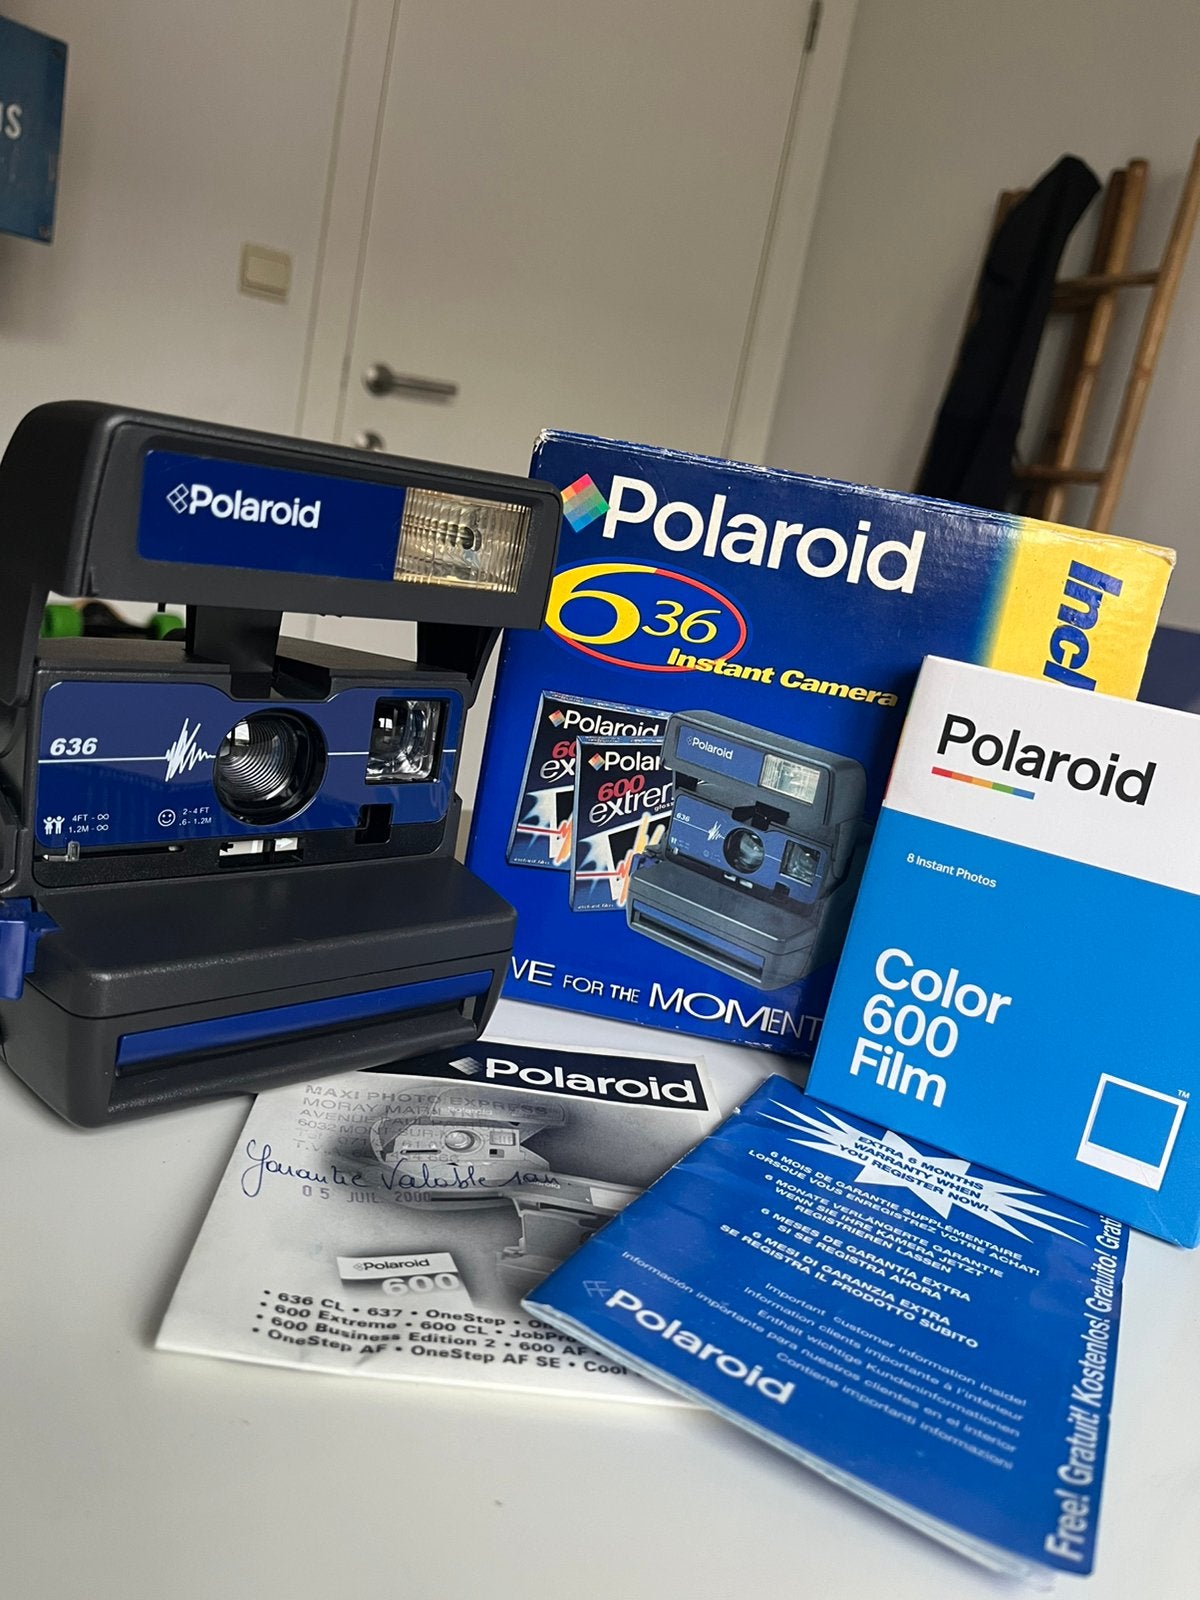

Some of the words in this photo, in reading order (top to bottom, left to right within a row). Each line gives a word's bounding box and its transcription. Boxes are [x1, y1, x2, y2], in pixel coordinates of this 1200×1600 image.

[189, 484, 321, 528] Polaroid
[603, 475, 926, 594] Polaroid
[545, 563, 722, 644] 636
[667, 648, 775, 684] Instant
[780, 670, 898, 708] Camera
[50, 738, 98, 756] 636
[692, 737, 733, 760] Polaroid
[937, 714, 1157, 806] Polaroid
[72, 814, 88, 822] 4FT
[598, 775, 645, 802] 600
[676, 812, 691, 822] 636
[68, 826, 90, 834] 1.2M
[907, 852, 916, 864] 8
[916, 854, 954, 876] Instant
[956, 868, 997, 889] Photos
[563, 974, 604, 997] FOR
[610, 984, 641, 1004] THE
[648, 982, 824, 1042] MOMENT
[875, 948, 1013, 1025] Color
[862, 994, 959, 1058] 600
[303, 1097, 378, 1113] MORAY
[306, 1084, 360, 1100] MAXI
[368, 1092, 440, 1103] PHOTO
[450, 1096, 548, 1115] EXPRESS
[486, 1058, 698, 1104] Polaroid
[850, 1036, 947, 1108] Film
[298, 1118, 337, 1132] 6032
[300, 1109, 377, 1123] AVENUE
[840, 1144, 869, 1161] YOU
[872, 1160, 944, 1195] REGISTER
[948, 1192, 989, 1212] NOW!
[854, 1142, 933, 1179] WARRANTY
[936, 1176, 981, 1199] WHEN
[858, 1136, 904, 1159] EXTRA
[921, 1162, 984, 1190] MONTHS
[748, 1150, 807, 1180] LORSQUE
[810, 1177, 843, 1196] VOUS
[846, 1193, 937, 1234] ENREGISTREZ
[940, 1231, 987, 1255] VOTRE
[988, 1252, 1040, 1277] ACHAT!
[775, 1186, 814, 1208] WENN
[816, 1204, 839, 1218] SIE
[841, 1214, 874, 1232] IHRE
[876, 1228, 935, 1259] KAMERA
[938, 1256, 984, 1277] JETZT
[776, 1179, 831, 1206] MONATE
[833, 1202, 930, 1247] VERLÄNGERTE
[932, 1244, 1004, 1279] GARANTIE
[781, 1156, 813, 1174] MOIS
[814, 1172, 833, 1183] DE
[836, 1180, 900, 1211] GARANTIE
[902, 1208, 1023, 1261] SUPPLÉMENTAIRE
[794, 1204, 894, 1250] REGISTRIEREN
[896, 1246, 952, 1274] LASSEN
[363, 1258, 431, 1271] Polaroid
[382, 1273, 460, 1297] 600
[720, 1224, 741, 1238] SE
[741, 1235, 811, 1275] REGISTRA
[814, 1272, 828, 1283] IL
[831, 1280, 916, 1321] PRODOTTO
[920, 1318, 979, 1349] SUBITO
[752, 1231, 762, 1239] 6
[764, 1237, 801, 1258] MESI
[802, 1256, 819, 1267] DI
[821, 1264, 896, 1303] GARANZIA
[900, 1298, 951, 1326] EXTRA
[772, 1213, 821, 1238] MESES
[822, 1234, 844, 1248] DE
[846, 1244, 918, 1280] GARANTÍA
[922, 1276, 971, 1303] EXTRA
[777, 1224, 792, 1235] SI
[794, 1232, 814, 1245] SE
[816, 1241, 887, 1278] REGISTRA
[889, 1274, 942, 1301] AHORA
[1085, 1248, 1119, 1314] Gratuito!
[271, 1316, 308, 1332] 600
[315, 1322, 401, 1343] Business
[408, 1332, 477, 1348] Edition
[485, 1338, 496, 1348] 2
[519, 1342, 555, 1353] 600
[562, 1344, 587, 1356] AF
[274, 1304, 311, 1319] 600
[318, 1310, 397, 1330] Extreme
[420, 1322, 457, 1332] 600
[464, 1324, 488, 1336] CL
[278, 1292, 314, 1306] 636
[321, 1298, 345, 1313] CL
[368, 1307, 403, 1318] 637
[426, 1309, 506, 1327] OneStep
[621, 1251, 694, 1294] Información
[696, 1291, 765, 1334] importante
[766, 1332, 798, 1351] para
[801, 1348, 861, 1382] nuestros
[864, 1378, 920, 1410] clientes
[922, 1406, 943, 1420] en
[946, 1416, 961, 1428] el
[744, 1286, 815, 1327] Information
[818, 1325, 862, 1350] clients
[864, 1346, 940, 1386] importante
[765, 1282, 827, 1317] Important
[833, 1316, 896, 1349] customer
[898, 1346, 976, 1386] information
[268, 1328, 353, 1353] OneStep
[360, 1344, 388, 1354] AF
[410, 1344, 495, 1364] OneStep
[502, 1354, 529, 1365] AF
[536, 1356, 561, 1368] SE
[584, 1360, 628, 1376] Cool
[606, 1288, 796, 1405] Polaroid
[757, 1309, 804, 1337] Enthält
[806, 1334, 863, 1366] wichtige
[866, 1362, 1021, 1438] Kundeninformationen
[1071, 1312, 1111, 1408] Kostenlos!
[776, 1352, 839, 1389] Contiene
[842, 1385, 917, 1426] importanti
[1057, 1404, 1100, 1487] Gratuit!
[1044, 1488, 1091, 1562] Free!
